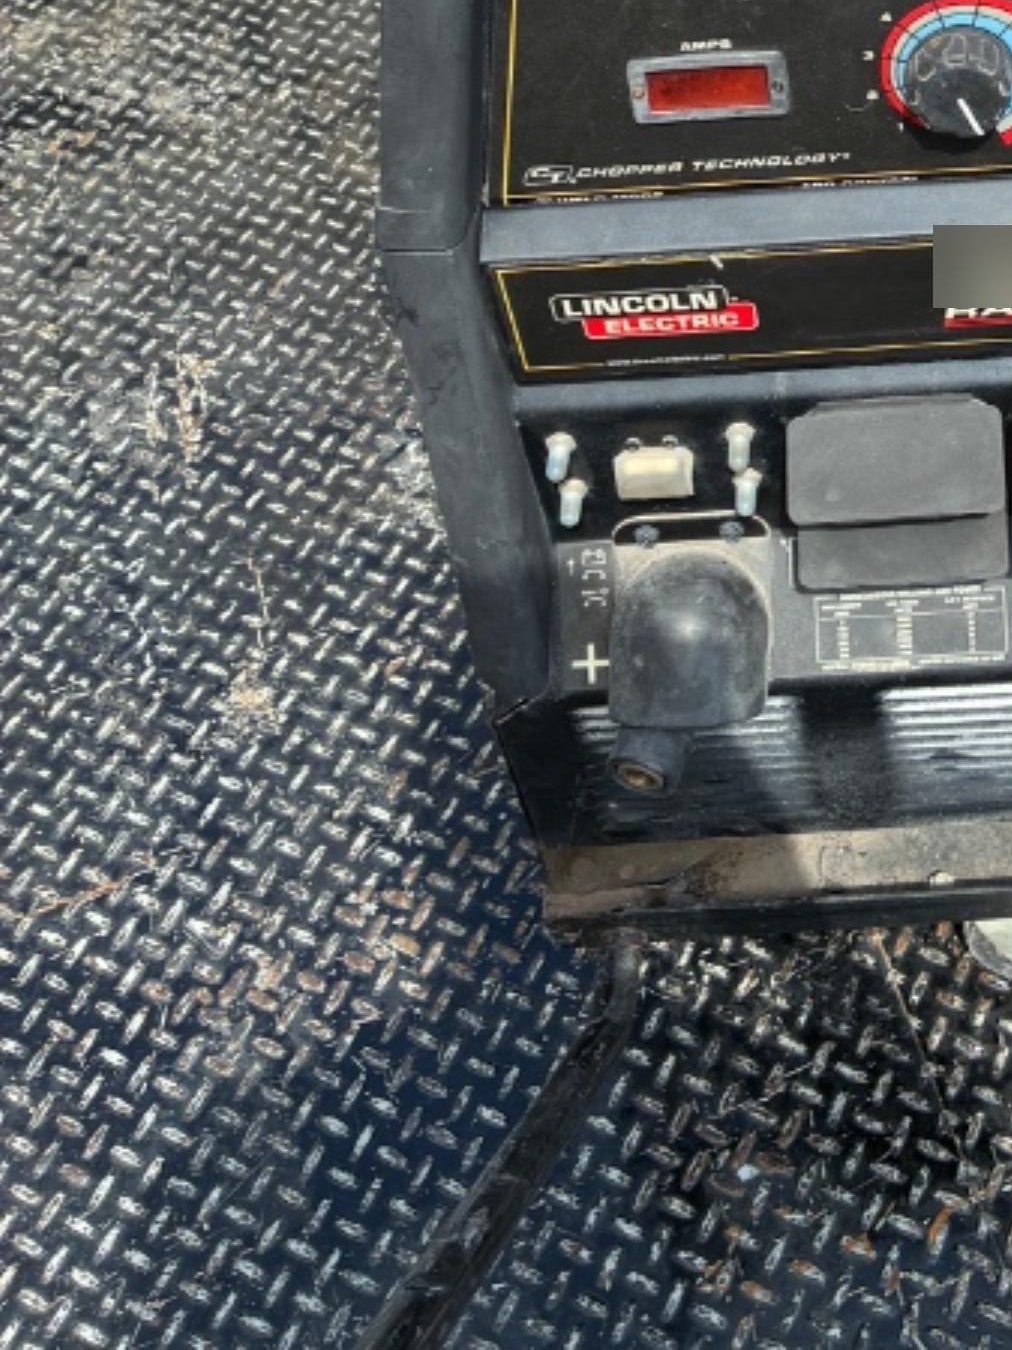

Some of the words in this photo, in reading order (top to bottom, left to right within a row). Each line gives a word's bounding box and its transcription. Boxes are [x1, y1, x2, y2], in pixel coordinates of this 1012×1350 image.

[680, 38, 733, 51] AMPS
[577, 161, 684, 178] CHOPPER
[562, 291, 719, 317] LINCOLN
[604, 312, 739, 334] ELECTRIC
